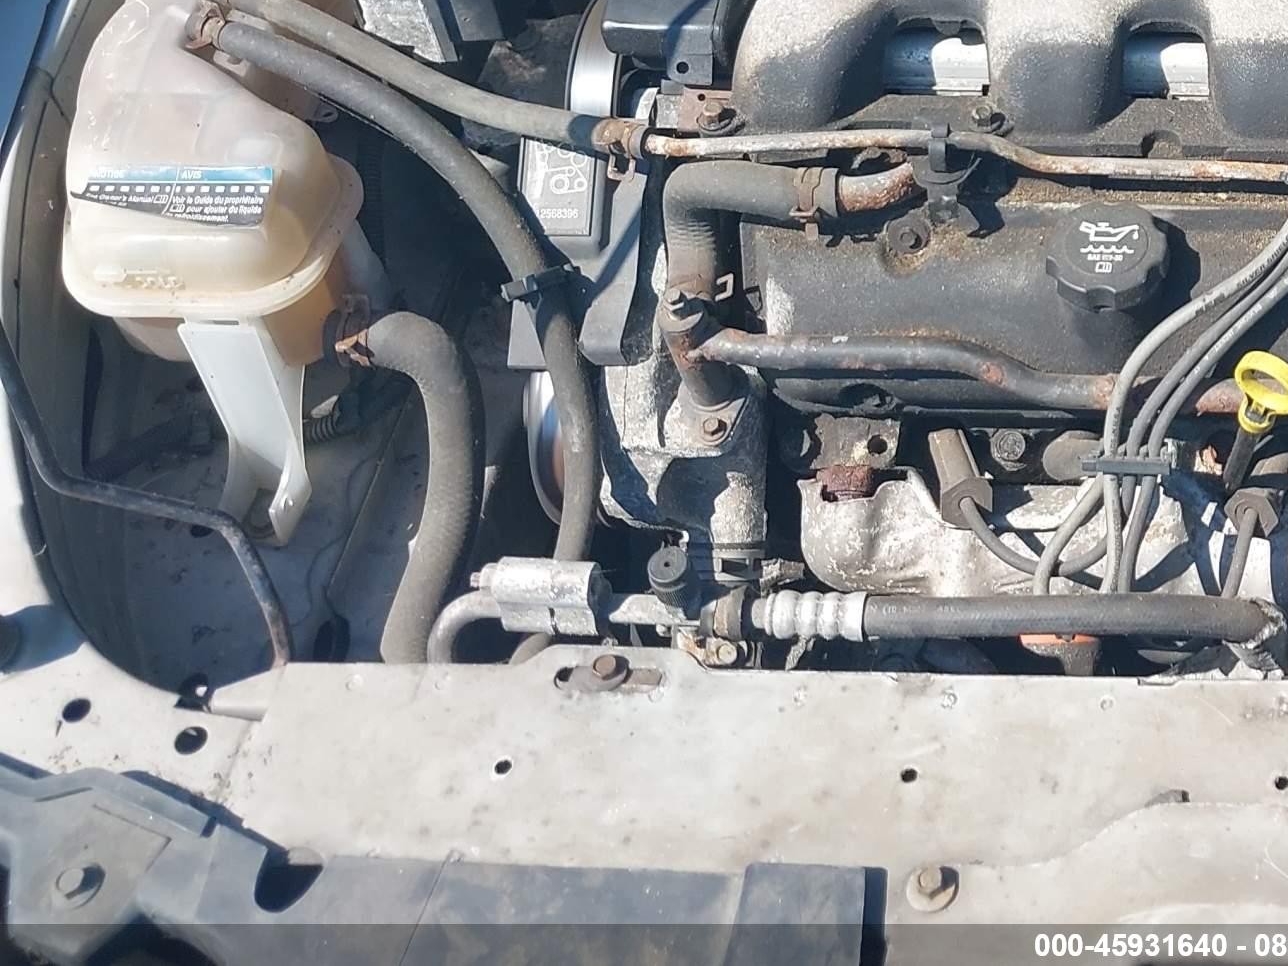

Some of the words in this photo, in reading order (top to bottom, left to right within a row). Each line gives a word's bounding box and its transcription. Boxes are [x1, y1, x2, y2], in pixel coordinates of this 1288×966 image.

[182, 170, 202, 179] AVIS
[128, 195, 154, 203] Manual
[173, 195, 186, 204] Voir
[187, 195, 193, 204] le
[194, 195, 213, 204] Guide
[214, 195, 224, 204] du
[186, 205, 203, 213] pour
[203, 205, 227, 214] ajouter
[228, 205, 238, 214] du
[239, 205, 262, 215] liquide
